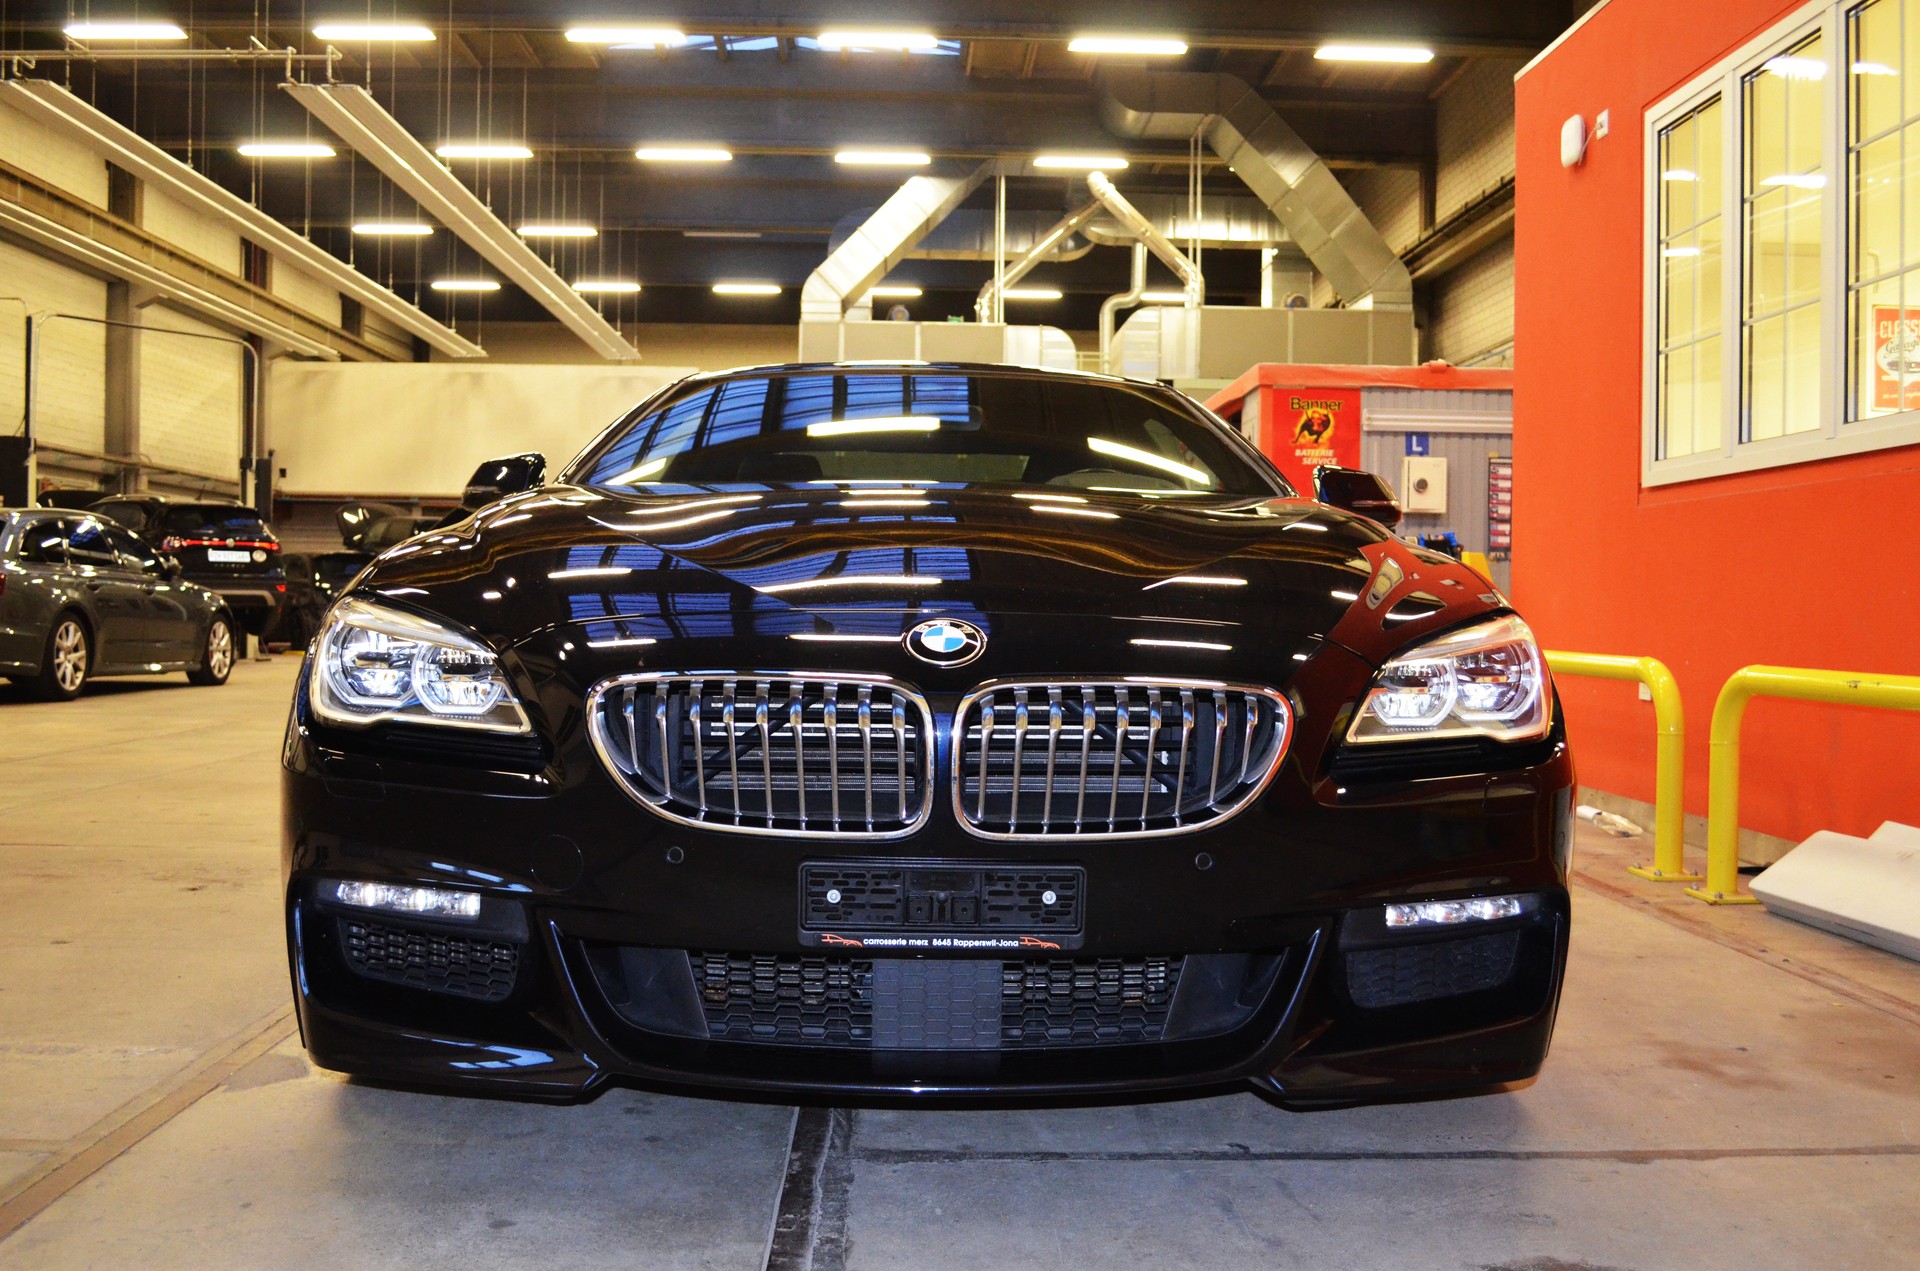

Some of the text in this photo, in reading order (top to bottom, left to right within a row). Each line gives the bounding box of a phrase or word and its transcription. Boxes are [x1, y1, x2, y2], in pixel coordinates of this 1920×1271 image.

[1291, 397, 1343, 410] Banner
[1412, 435, 1423, 451] L
[1295, 448, 1334, 457] BATTERIE
[1302, 457, 1338, 466] SERVICE
[863, 937, 907, 946] carrosserie
[932, 938, 952, 947] 8645
[953, 938, 1019, 948] Rapperswil-Jona
